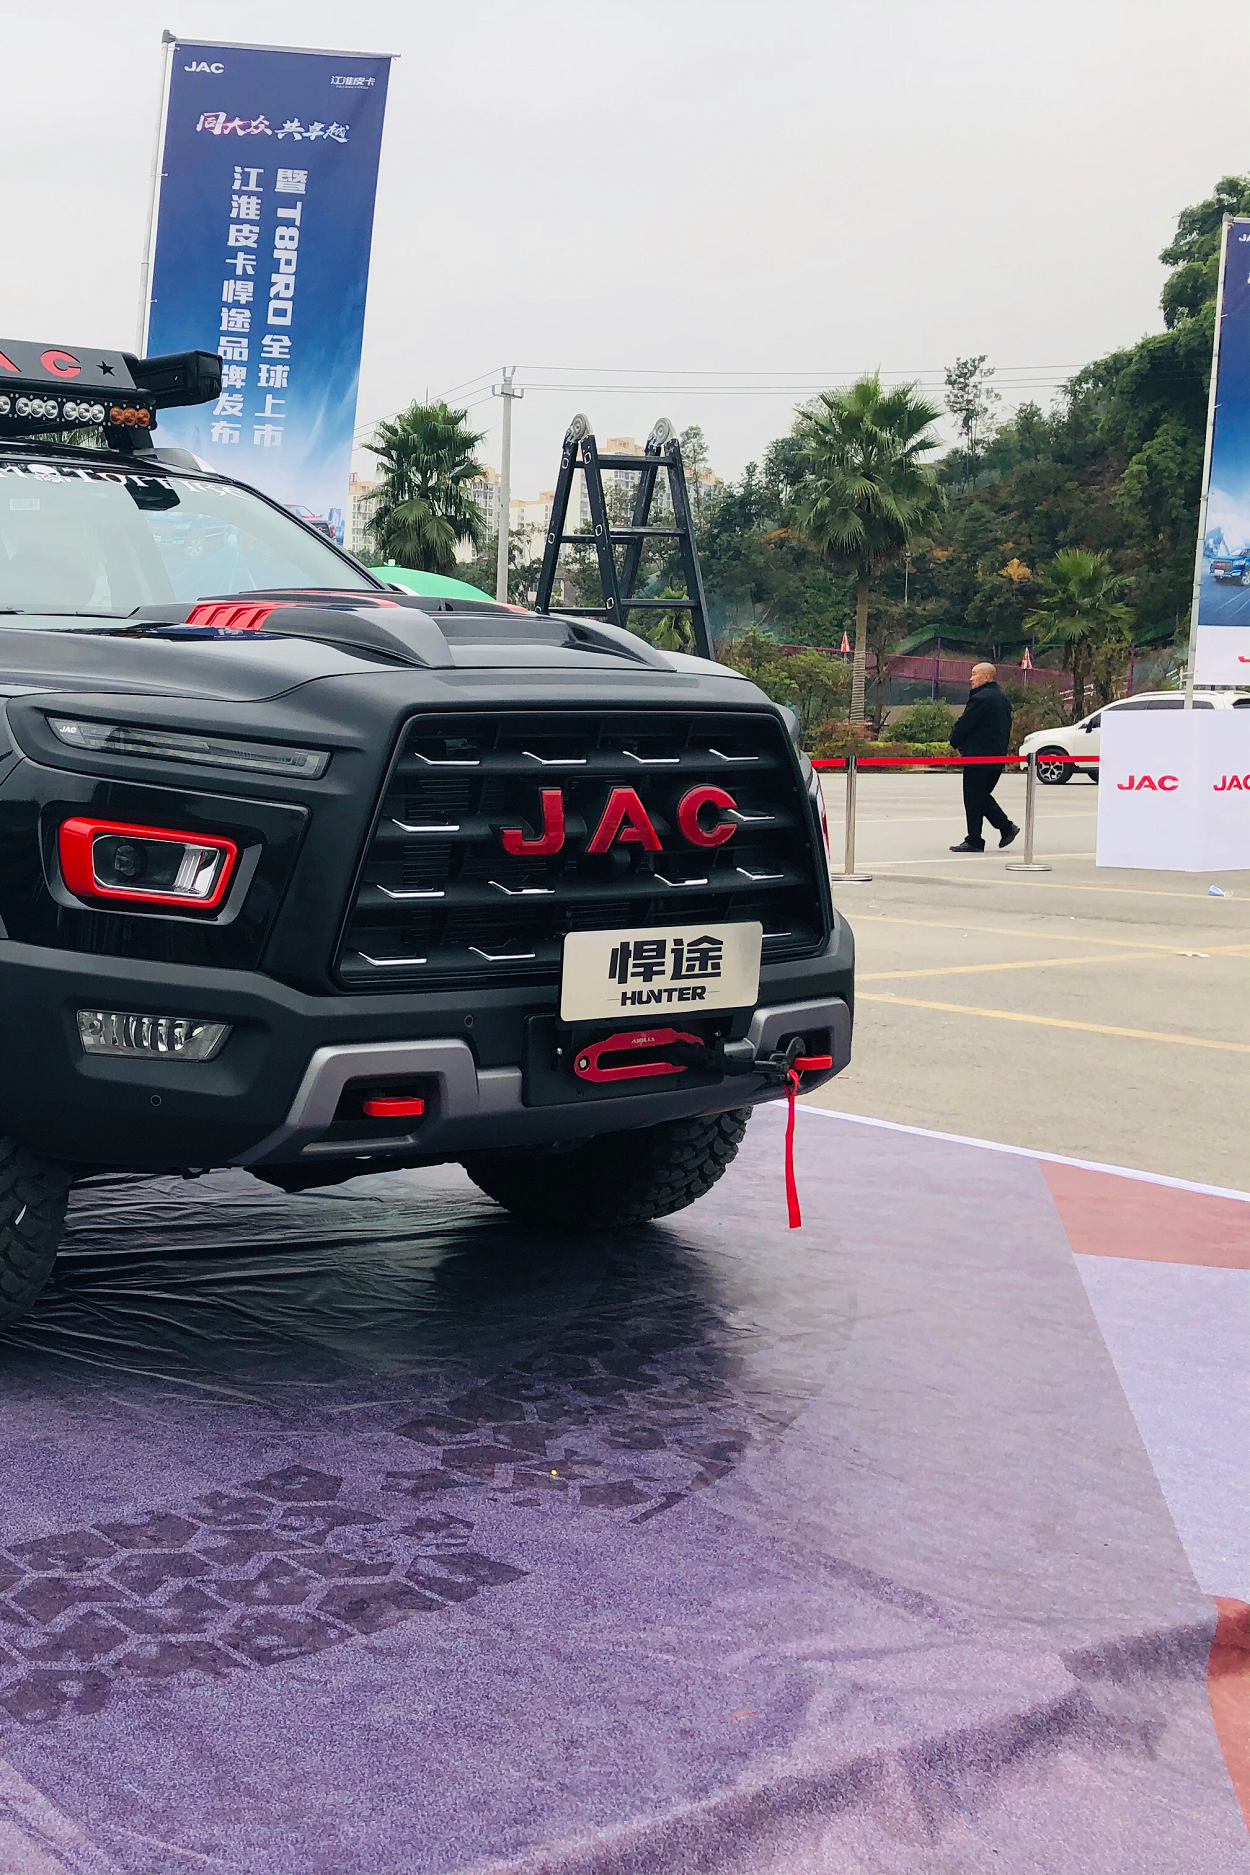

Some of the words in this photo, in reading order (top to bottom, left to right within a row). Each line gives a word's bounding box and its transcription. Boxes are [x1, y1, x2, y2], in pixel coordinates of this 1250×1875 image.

[184, 61, 225, 74] JAC
[330, 75, 376, 86] 江淮皮卡
[211, 165, 265, 444] 江淮皮卡悍途品牌发布
[59, 725, 77, 733] JAC
[1117, 775, 1179, 791] JAC
[502, 785, 738, 855] JAC
[608, 935, 724, 984] 悍途
[620, 985, 707, 1006] HUNTER
